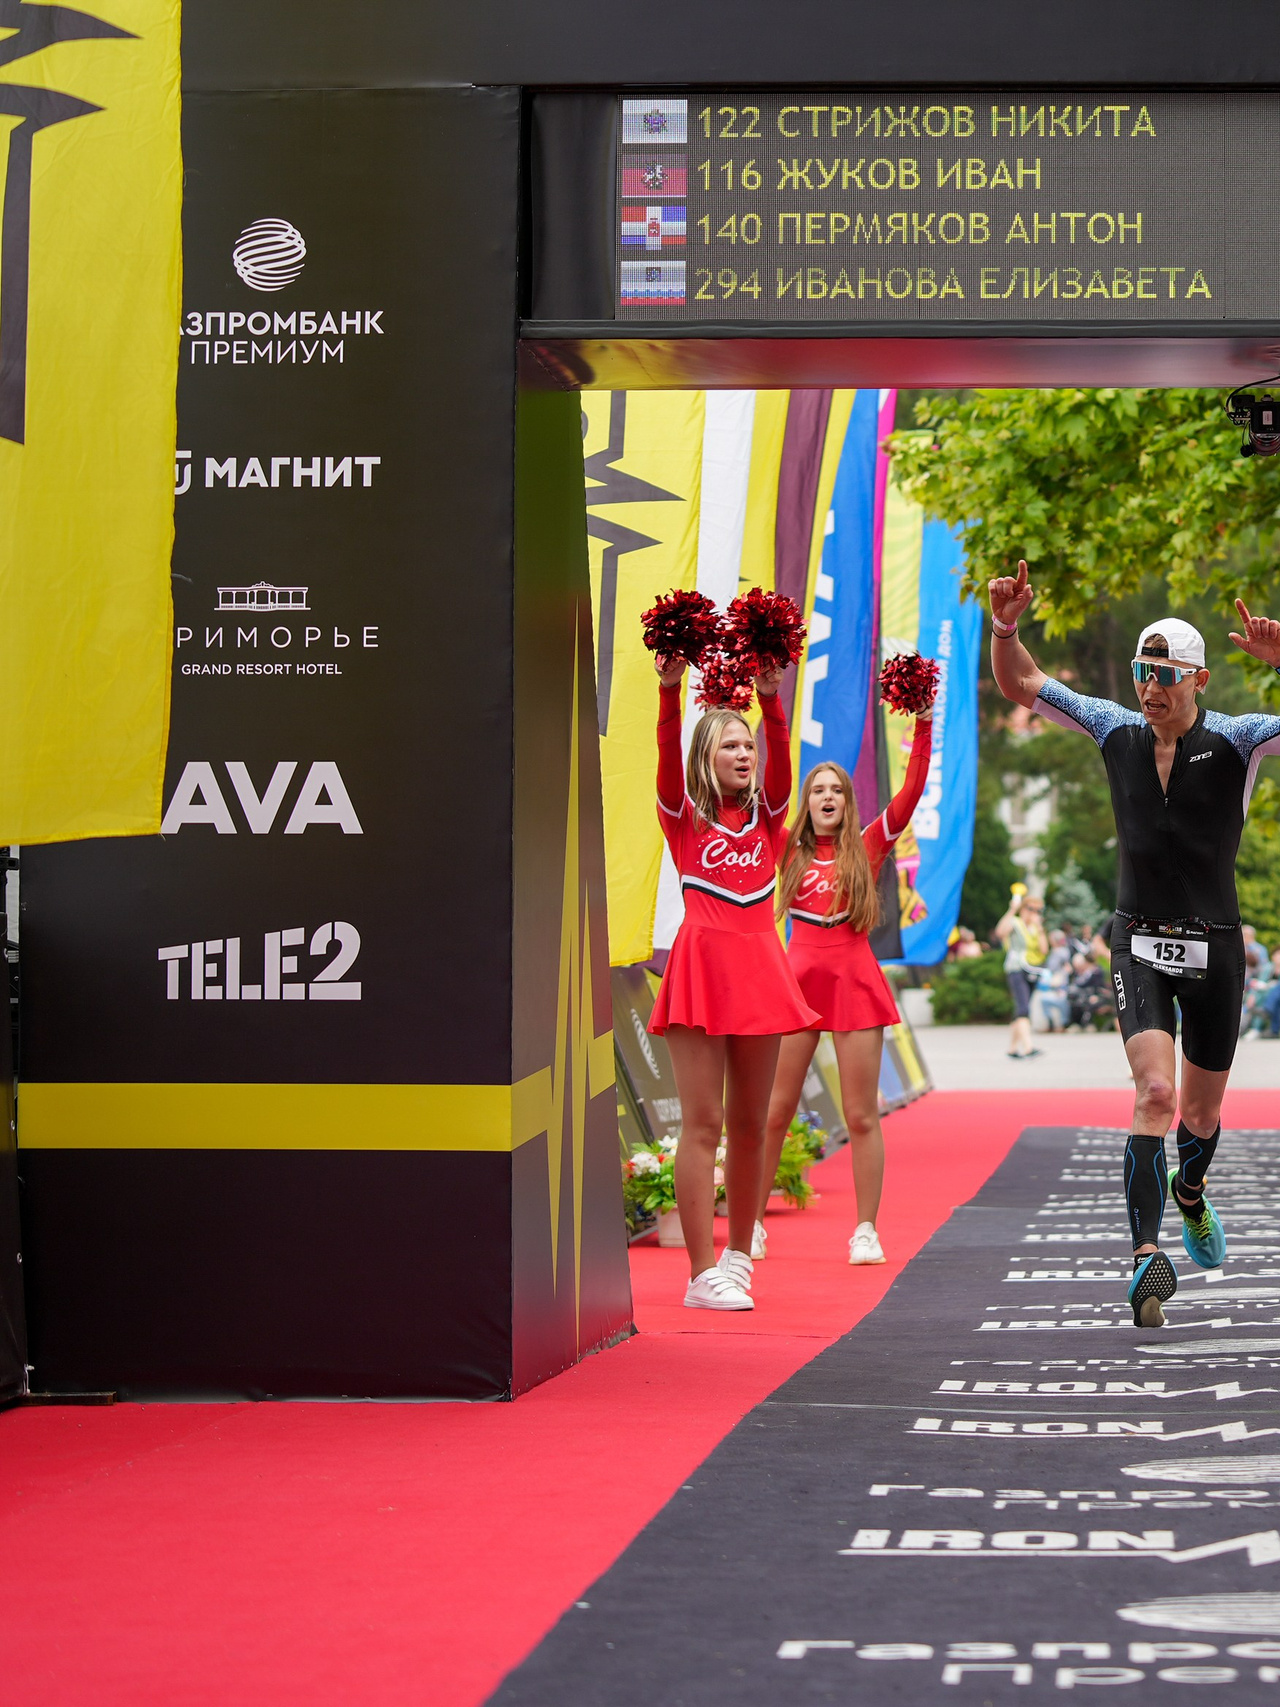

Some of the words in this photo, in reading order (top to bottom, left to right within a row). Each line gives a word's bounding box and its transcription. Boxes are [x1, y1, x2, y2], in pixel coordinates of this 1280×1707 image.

[698, 106, 761, 137] 122
[777, 106, 973, 137] СТРИЖОВ
[992, 106, 1156, 137] НИКИТА
[698, 159, 761, 190] 116
[778, 159, 920, 190] ЖУКОВ
[938, 159, 1041, 190] ИВАН
[699, 213, 762, 244] 140
[778, 213, 990, 244] ПЕРМЯКОВ
[1005, 213, 1142, 244] АНТОН
[694, 268, 762, 299] 294
[777, 268, 963, 299] ИВАНОВА
[981, 268, 1211, 299] ЕЛИЗАВЕТА
[191, 340, 344, 364] ПРЕМИУМ
[205, 457, 381, 487] МАГНИТ
[176, 626, 379, 648] РИМОРЬЕ
[181, 664, 232, 675] GRAND
[236, 664, 292, 675] RESORT
[296, 664, 342, 675] HOTEL
[160, 761, 364, 834] AVA
[701, 838, 763, 869] Cool
[158, 922, 361, 1000] TELE2
[1153, 942, 1186, 962] 152
[1007, 1270, 1135, 1279] IRO
[938, 1379, 1166, 1392] IRON
[912, 1418, 1164, 1433] IRON
[850, 1529, 1176, 1550] IRON
